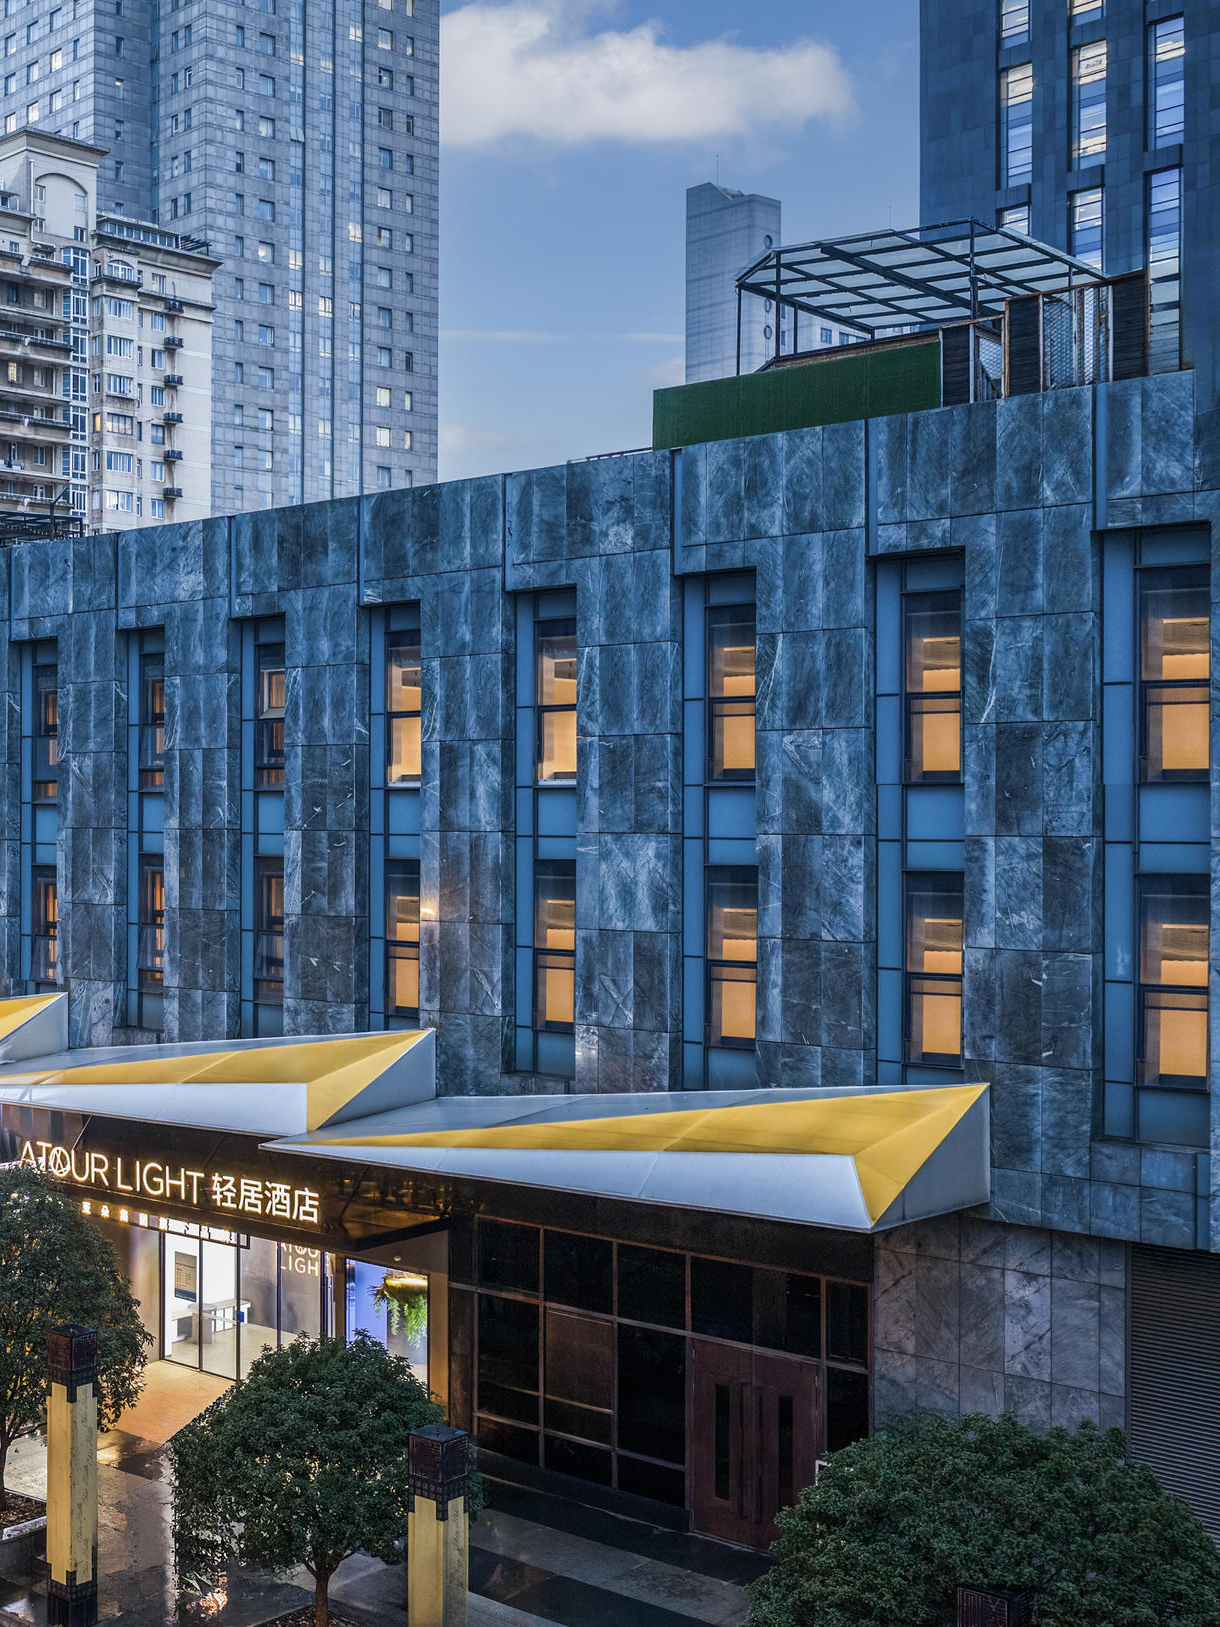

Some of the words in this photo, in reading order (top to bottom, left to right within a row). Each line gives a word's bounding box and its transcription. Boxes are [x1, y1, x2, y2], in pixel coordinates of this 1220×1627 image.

[20, 1140, 109, 1187] ATOUR
[117, 1157, 205, 1205] LIGHT
[211, 1172, 320, 1224] 轻居酒店
